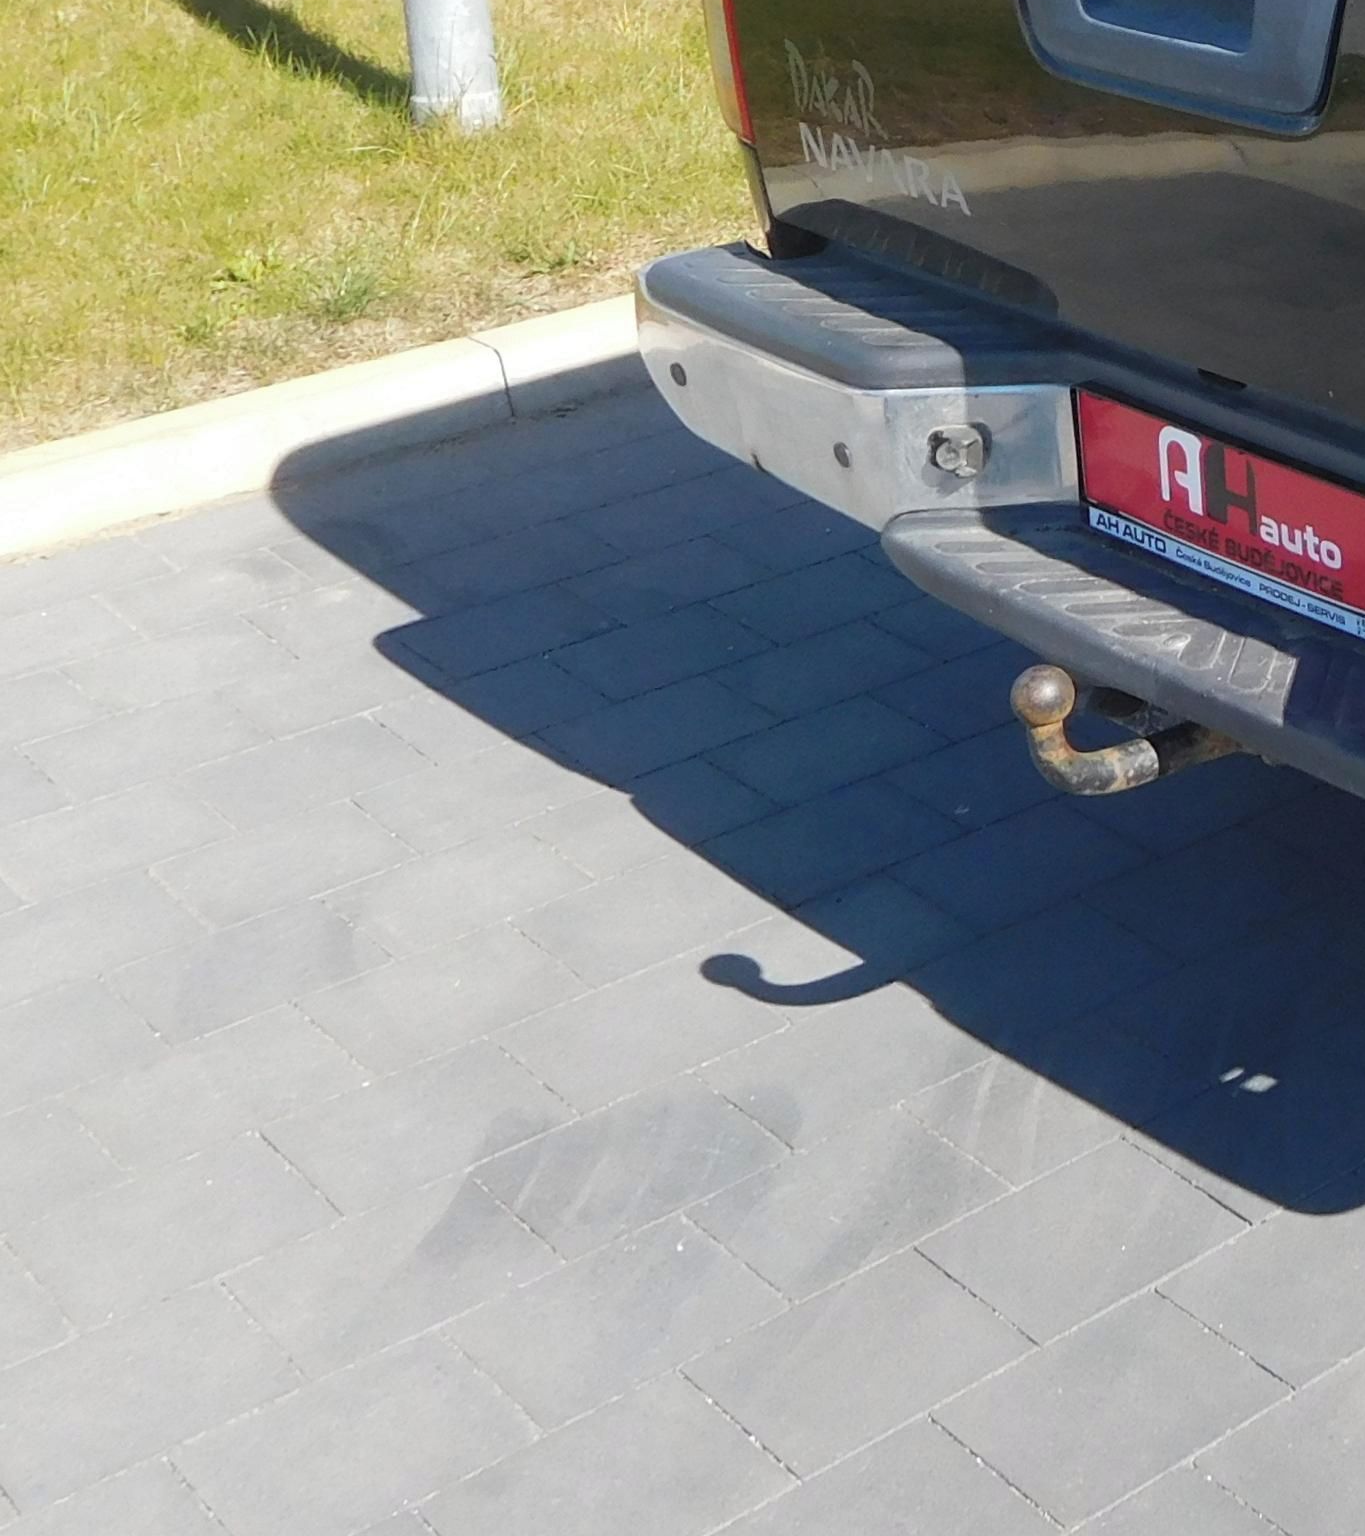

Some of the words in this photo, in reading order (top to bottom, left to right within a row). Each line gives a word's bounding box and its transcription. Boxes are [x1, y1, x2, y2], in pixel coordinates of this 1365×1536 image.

[785, 38, 889, 140] DAKAR
[799, 121, 972, 216] NAVARA
[1096, 514, 1119, 534] AH
[1122, 523, 1167, 554] AUTO
